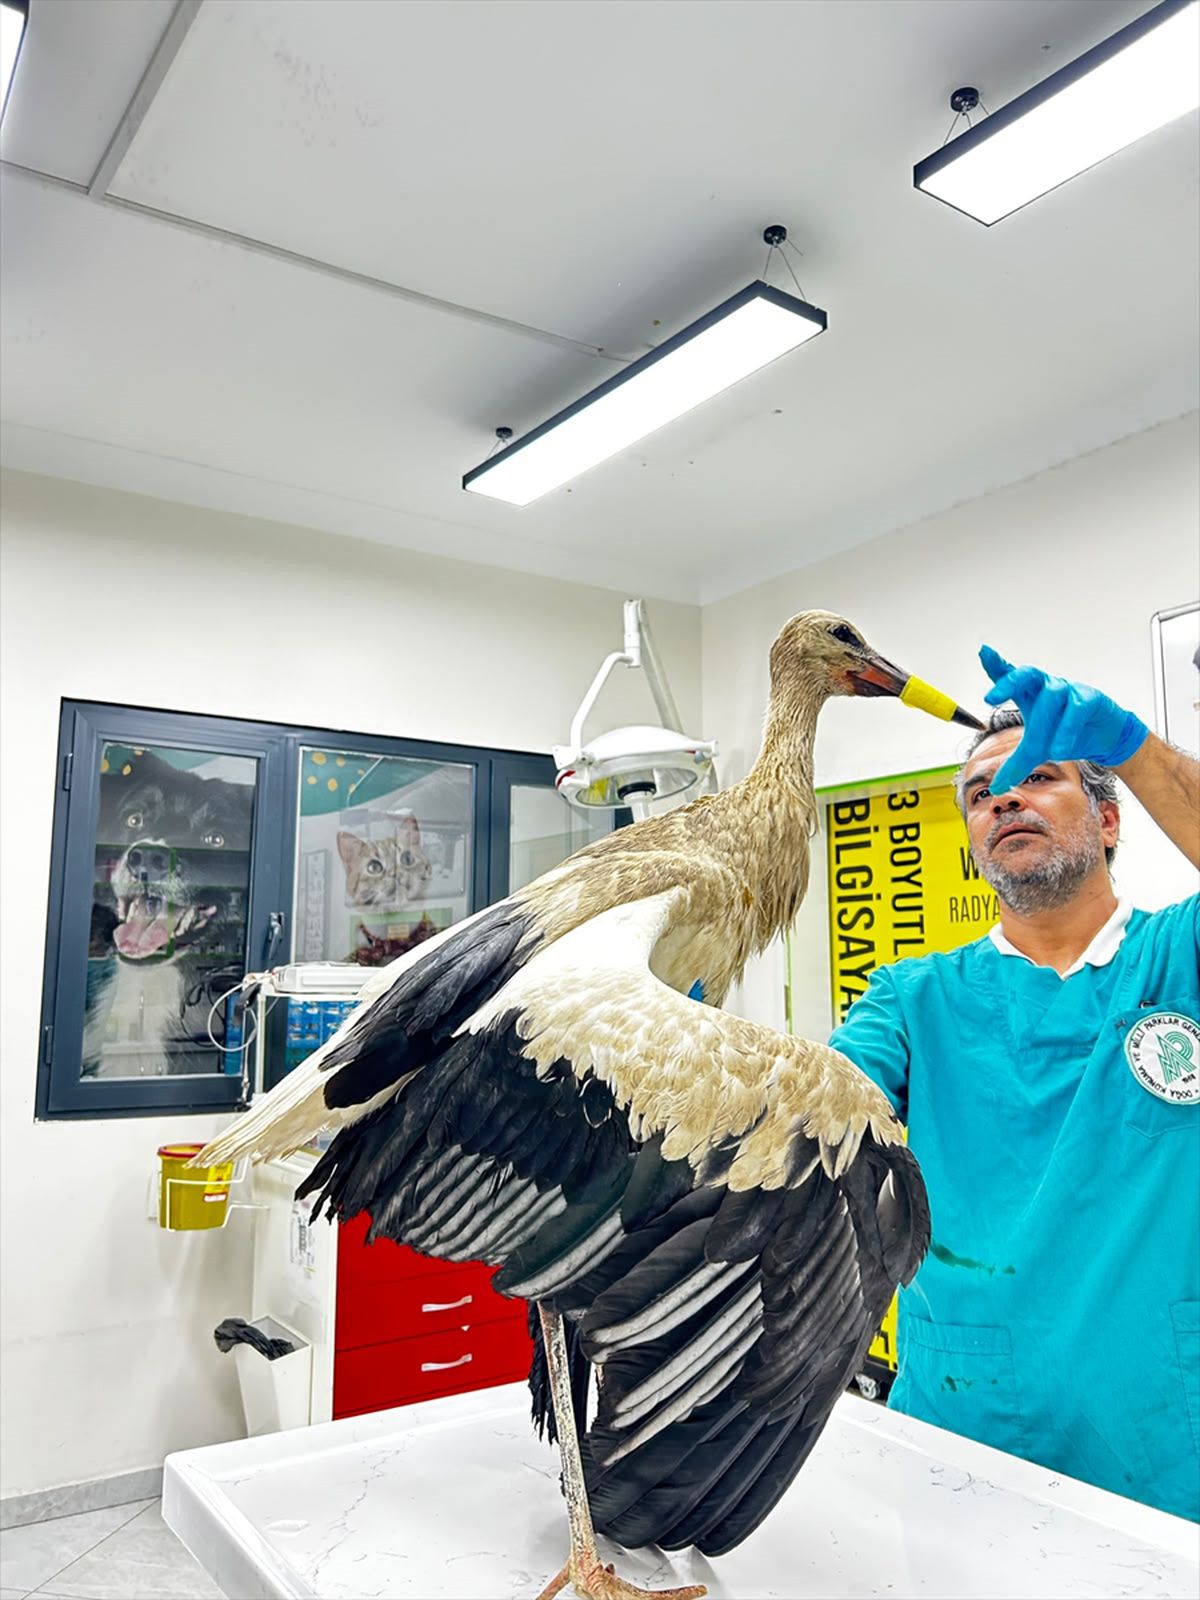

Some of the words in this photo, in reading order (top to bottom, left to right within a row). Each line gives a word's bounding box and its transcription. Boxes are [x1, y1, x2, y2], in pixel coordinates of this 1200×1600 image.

[887, 790, 919, 811] 3
[834, 797, 881, 1024] BİLGİSAYA
[888, 821, 925, 963] BOYUTL
[949, 894, 1000, 922] RADYA
